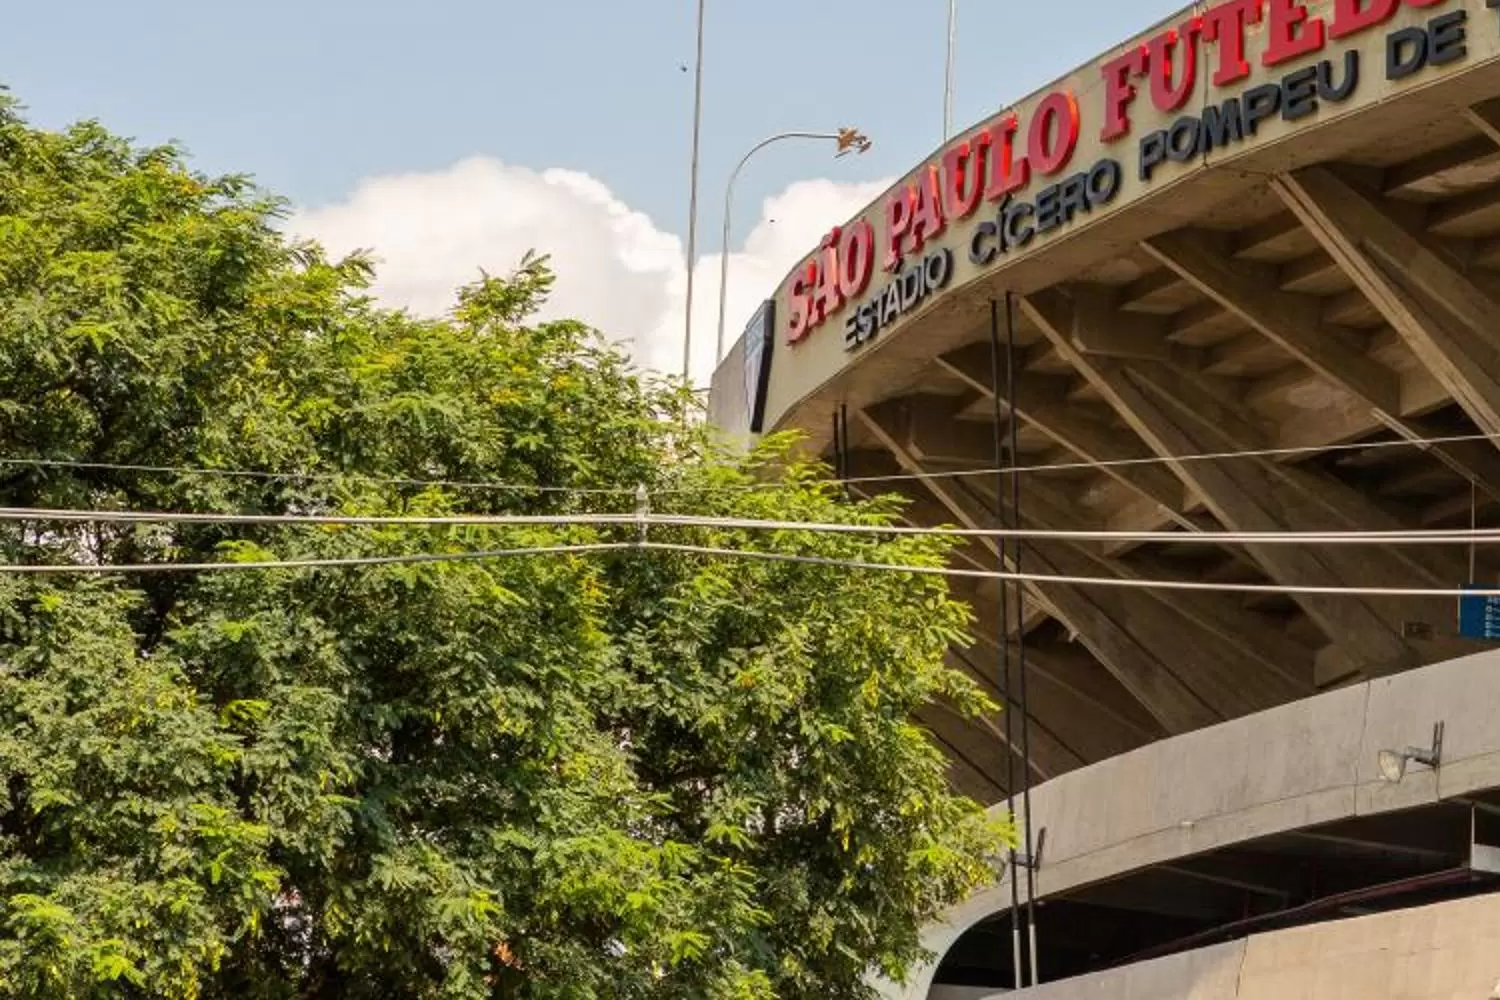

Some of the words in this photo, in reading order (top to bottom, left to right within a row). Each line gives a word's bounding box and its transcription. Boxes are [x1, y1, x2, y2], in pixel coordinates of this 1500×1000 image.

[786, 218, 875, 345] SÃO
[883, 90, 1080, 271] PAULO
[842, 248, 953, 351] ESTÁDIO
[969, 159, 1121, 265] CÍCERO
[1139, 50, 1359, 180] POMPEU
[1386, 10, 1466, 80] DE
